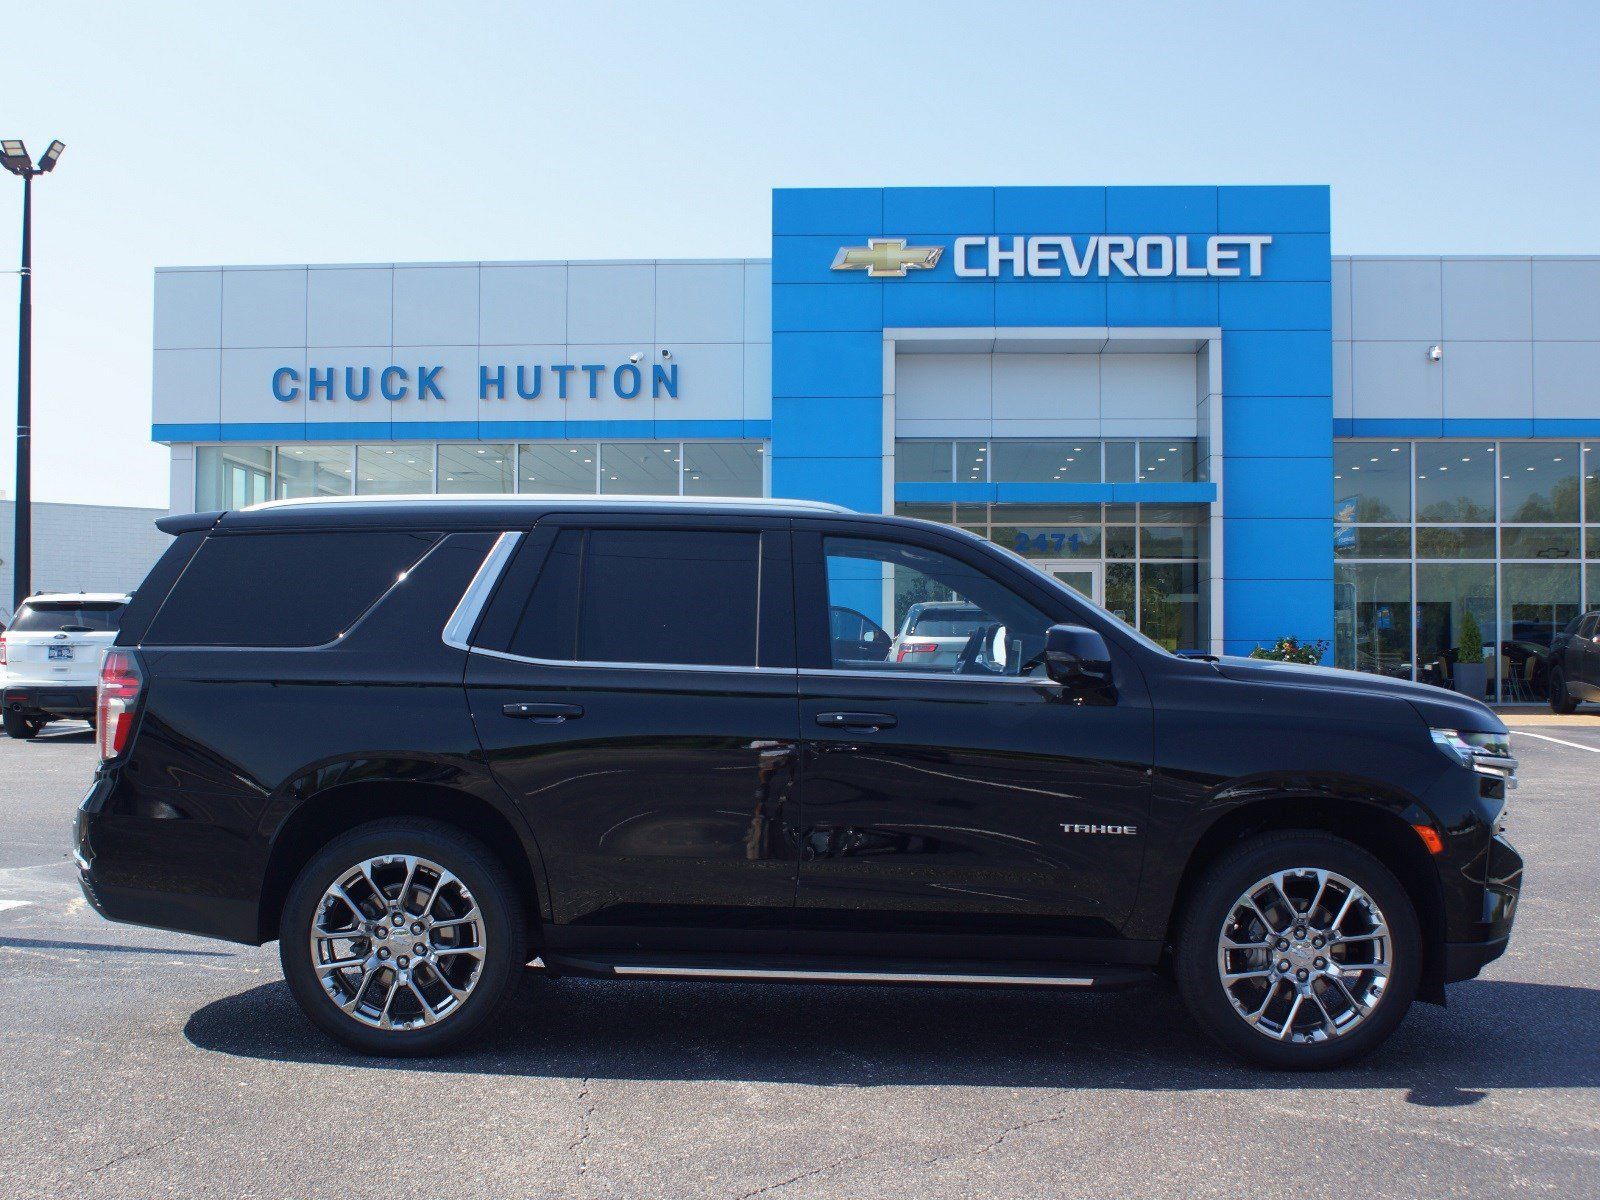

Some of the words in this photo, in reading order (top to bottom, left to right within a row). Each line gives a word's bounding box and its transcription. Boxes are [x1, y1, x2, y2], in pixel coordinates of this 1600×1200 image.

[953, 235, 1273, 278] CHEVROLET
[272, 365, 446, 402] CHUCK
[479, 363, 679, 400] HUTTON
[1013, 531, 1080, 553] 2471
[1059, 823, 1137, 835] TAHOE
